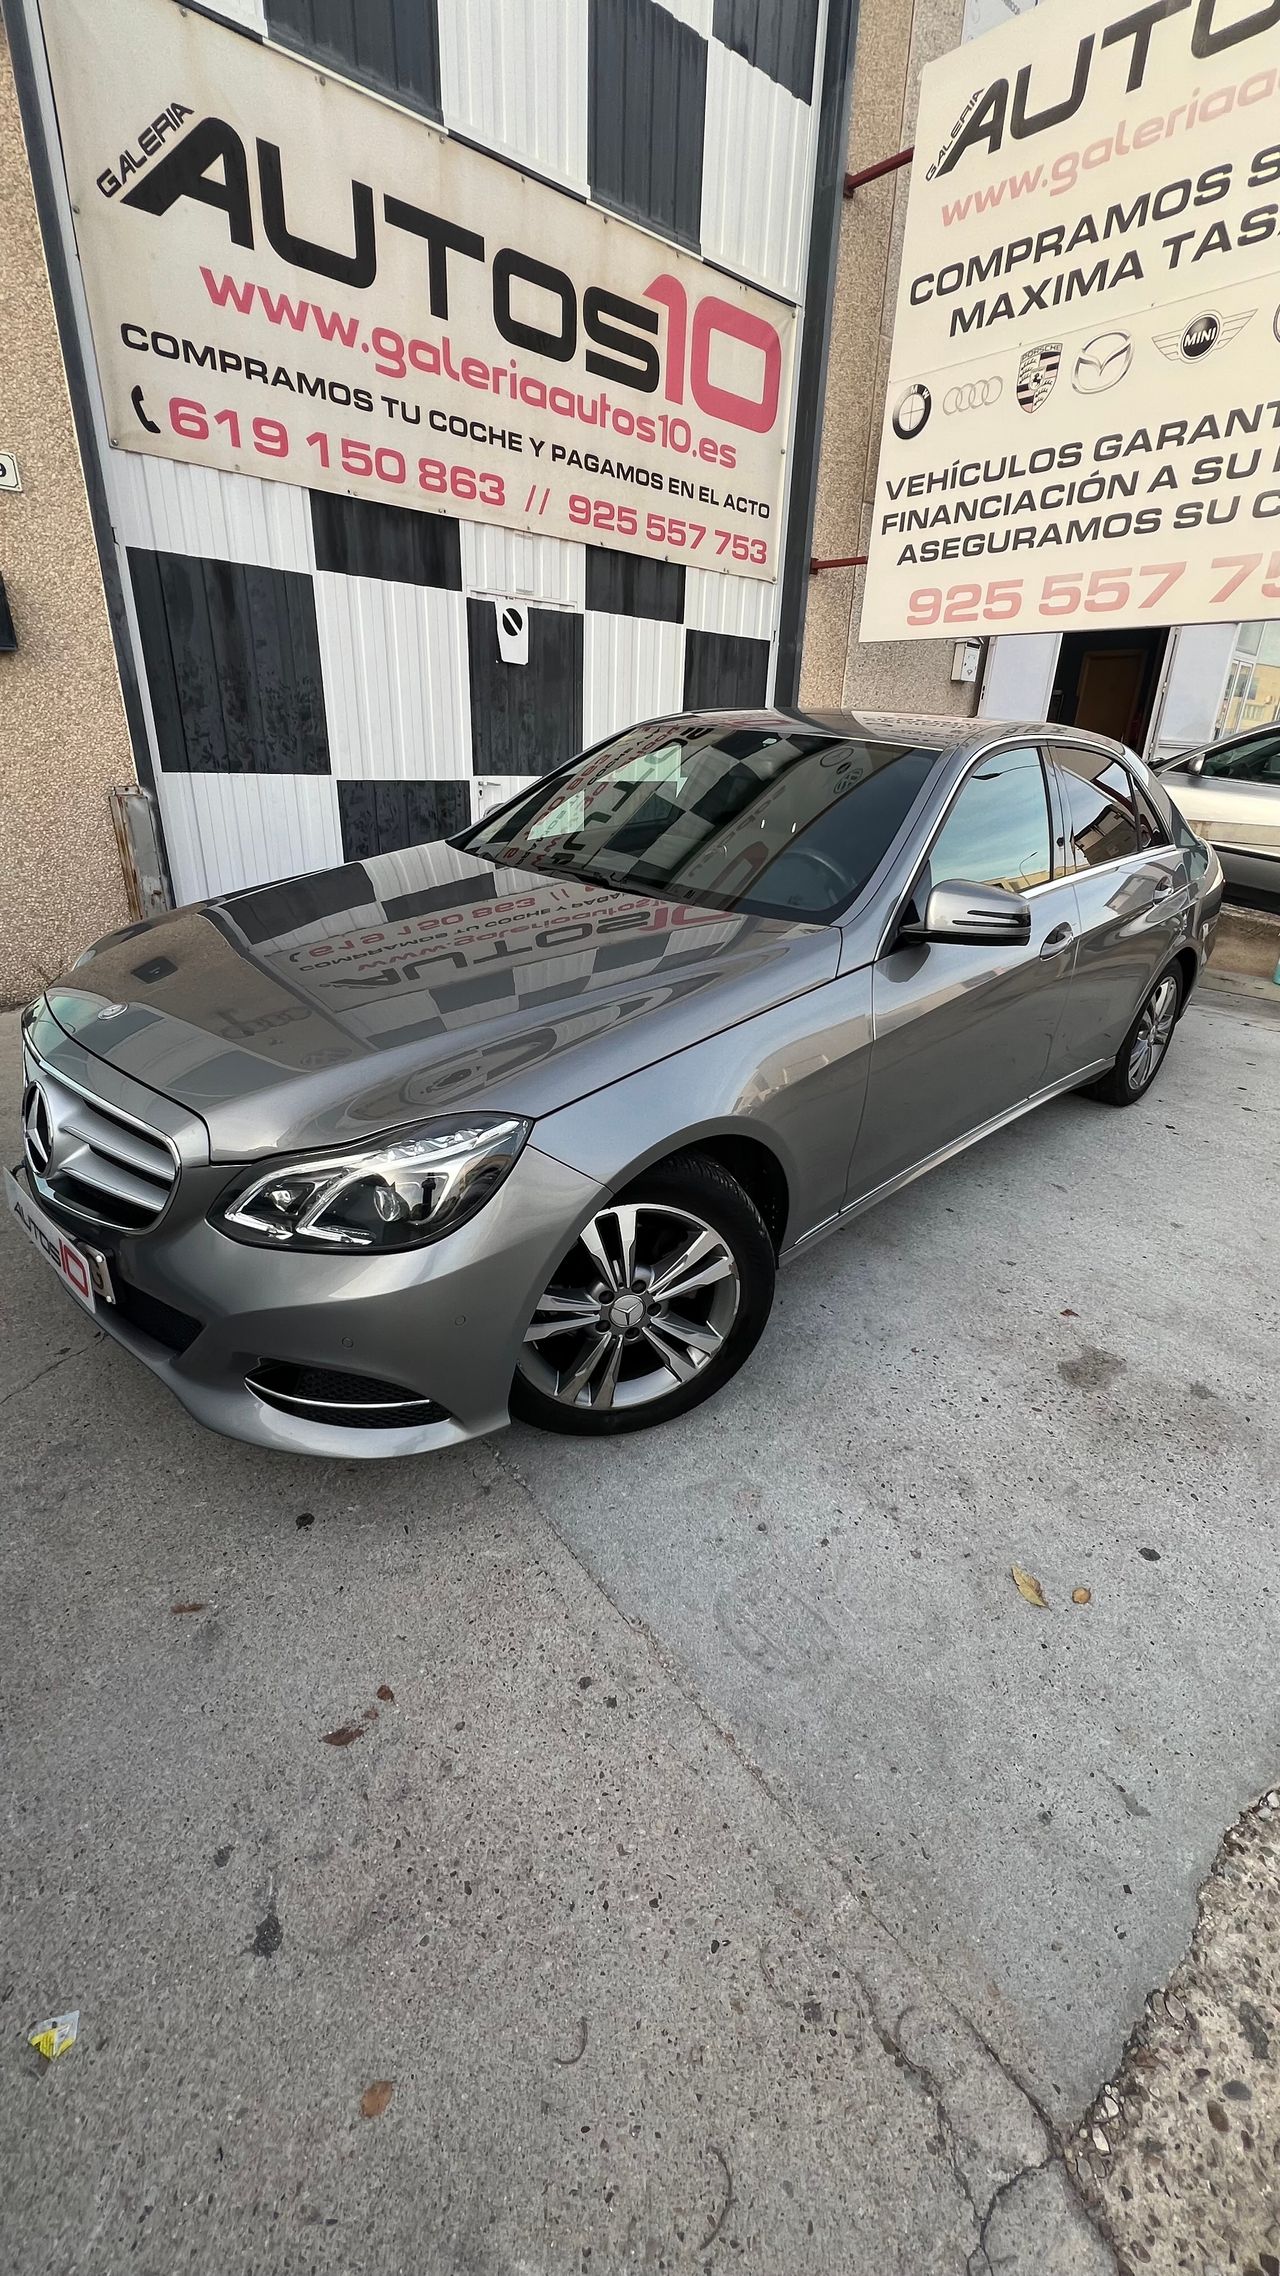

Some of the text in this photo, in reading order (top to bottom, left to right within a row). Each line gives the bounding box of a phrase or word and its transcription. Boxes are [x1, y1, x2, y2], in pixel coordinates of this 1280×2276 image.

[96, 102, 195, 198] GALERIA
[925, 88, 984, 182] GALERIA
[941, 67, 1280, 227] www.galeriaa
[119, 116, 782, 434] AUTOS10
[910, 163, 1232, 306] COMPRAMOS
[949, 203, 1280, 338] MAXIMA TAS
[199, 265, 737, 469] www.galeriaautos10.es
[1184, 327, 1216, 346] MINI
[120, 322, 771, 519] COMPRAMOS TU COCHE Y PAGAMOS EN EL ACTO
[168, 396, 289, 458] 619
[306, 431, 406, 484] 150
[418, 457, 506, 507] 863
[568, 494, 638, 536] 925
[645, 512, 707, 550] 557
[714, 529, 767, 564] 753
[881, 470, 1139, 536] FINANCIACIÓN
[1147, 464, 1179, 492] A
[1191, 448, 1262, 485] SU
[886, 441, 1083, 501] VEHÍCULOS
[897, 507, 1162, 566] ASEGURAMOS
[1173, 494, 1239, 530] SU
[906, 578, 1024, 626] 925
[1038, 561, 1187, 617] 557
[13, 1201, 89, 1298] AUTOS10
